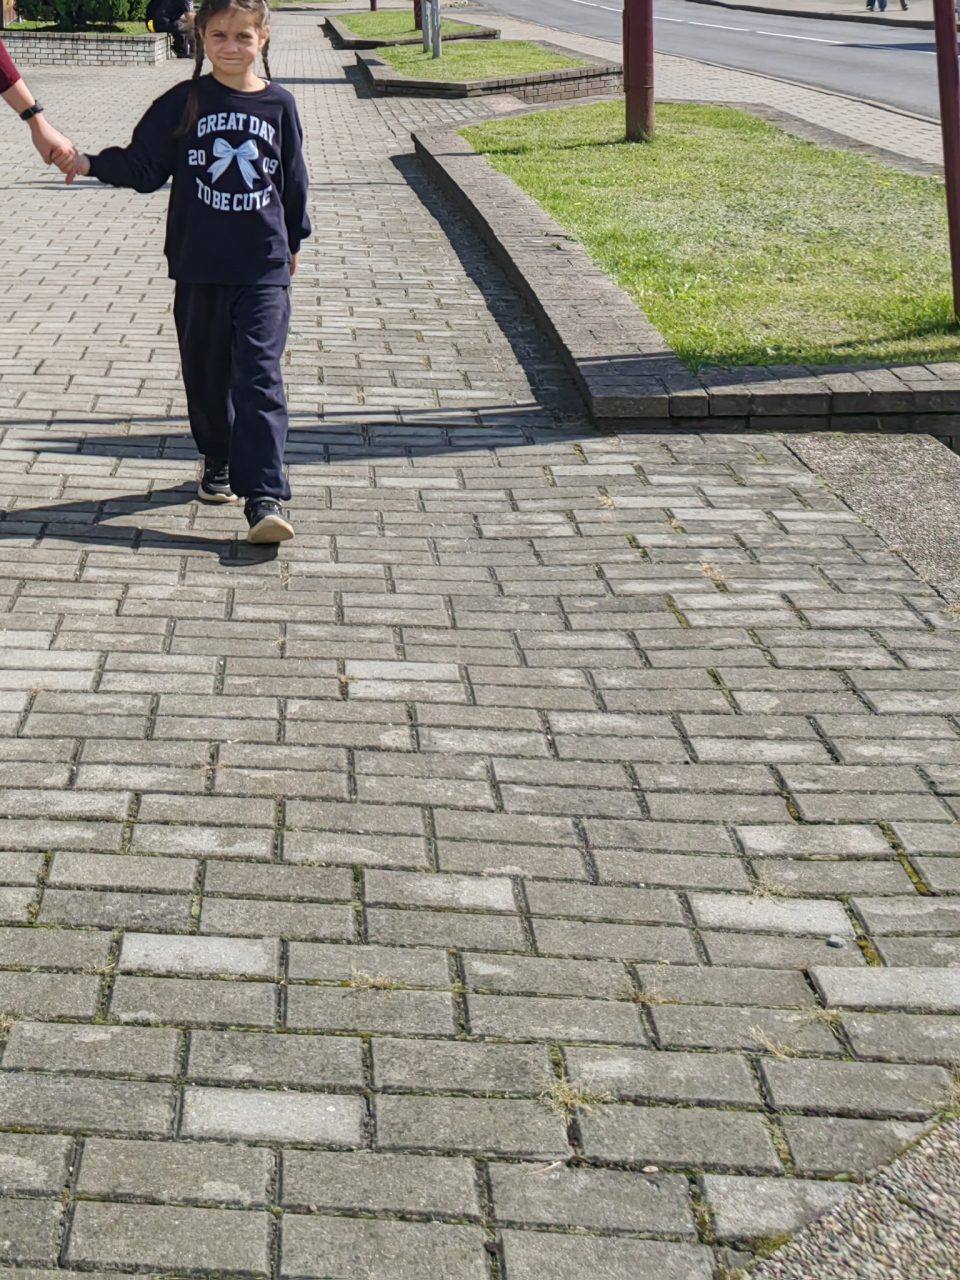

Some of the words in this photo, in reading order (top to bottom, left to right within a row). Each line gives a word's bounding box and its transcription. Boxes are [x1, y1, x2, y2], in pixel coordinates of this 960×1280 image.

[197, 112, 247, 138] GREAT
[249, 115, 276, 146] DAY
[188, 149, 206, 166] 20
[262, 157, 279, 174] 09
[195, 177, 211, 205] TO
[212, 189, 231, 211] BE
[233, 184, 273, 211] CUTE
